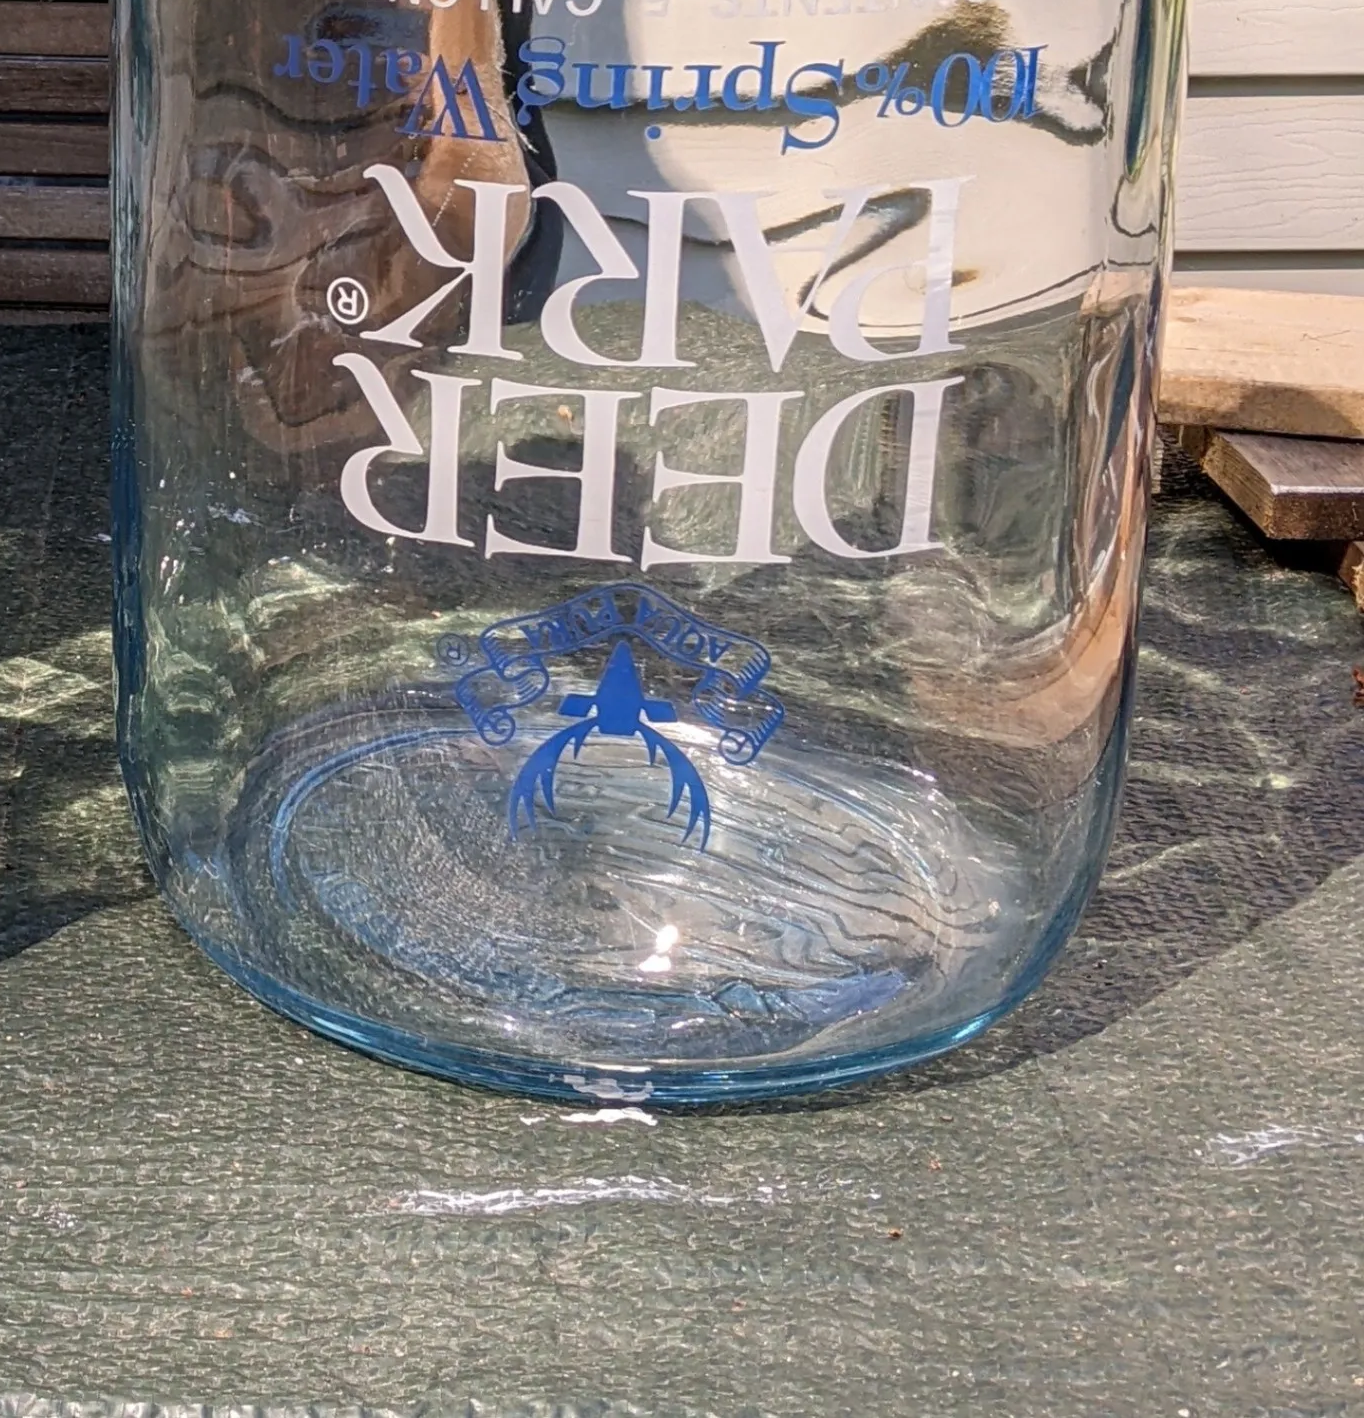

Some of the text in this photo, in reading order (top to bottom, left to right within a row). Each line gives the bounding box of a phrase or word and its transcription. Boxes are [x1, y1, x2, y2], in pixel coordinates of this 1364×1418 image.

[274, 33, 1048, 155] 100% Spring Water
[360, 163, 974, 373] PARK
[332, 352, 965, 571] DEER
[518, 593, 732, 663] AQUA PURA
